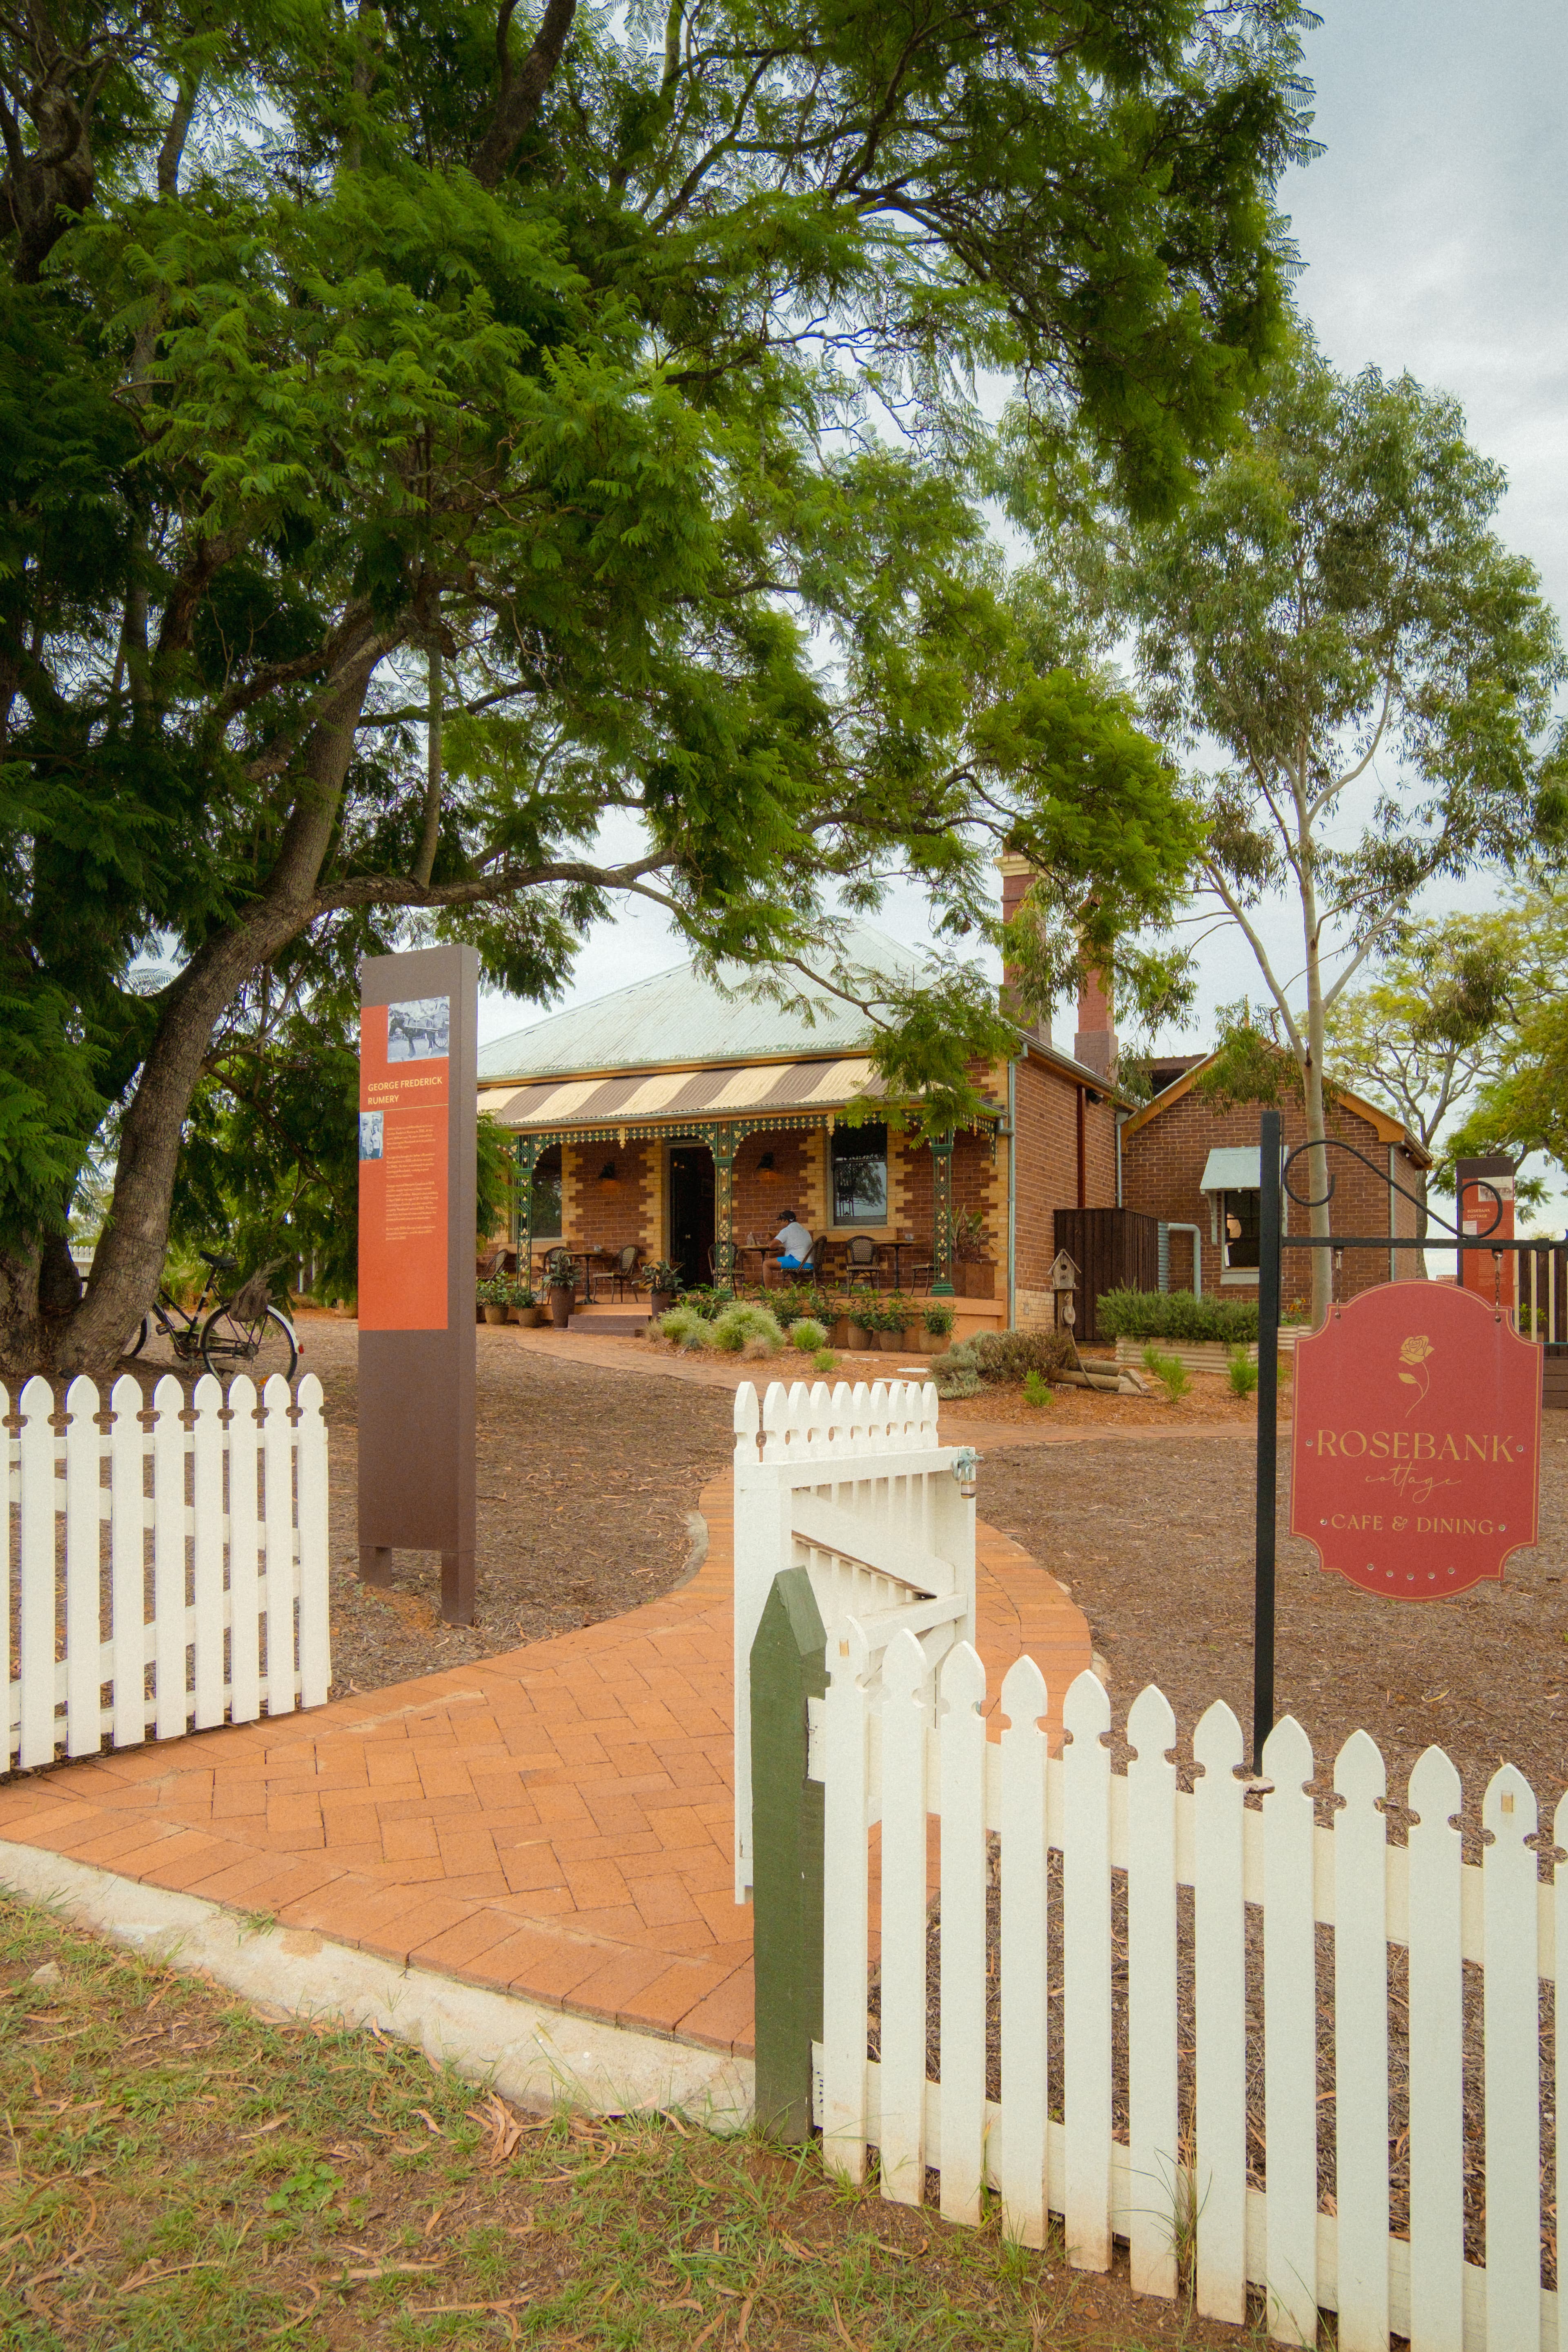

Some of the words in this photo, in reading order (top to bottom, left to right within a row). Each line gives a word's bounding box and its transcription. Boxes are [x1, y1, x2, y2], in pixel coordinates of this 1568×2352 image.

[368, 1081, 399, 1092] GEORGE
[400, 1076, 443, 1088] FREDERICK
[368, 1094, 399, 1105] RUMERY
[1317, 1430, 1515, 1462] ROSEBANK
[1365, 1461, 1462, 1503] cottage
[1331, 1514, 1383, 1531] CAFE
[1392, 1515, 1408, 1531] &
[1417, 1517, 1494, 1535] DINING
